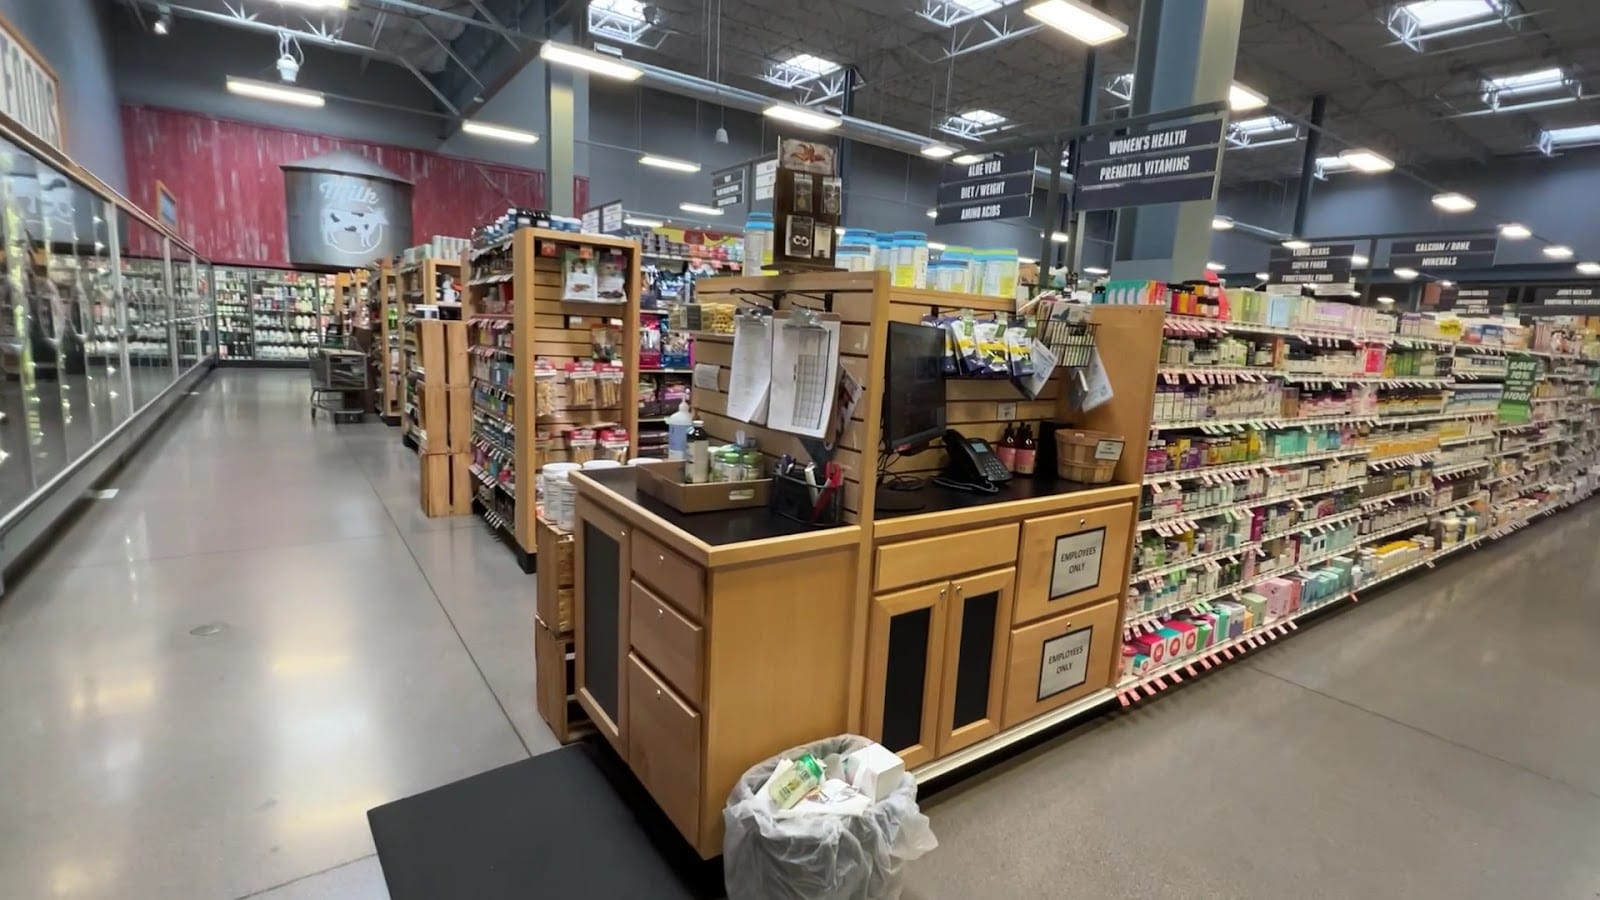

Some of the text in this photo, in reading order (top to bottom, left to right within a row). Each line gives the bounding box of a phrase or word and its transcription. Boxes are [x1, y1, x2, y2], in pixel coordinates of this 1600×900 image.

[1109, 129, 1187, 155] WOMEN'S HEALTH
[967, 160, 1001, 178] ALOE VERA
[1100, 155, 1190, 181] PRENATAL VITAMINS
[319, 182, 379, 204] Milk
[961, 185, 975, 200] DIET
[980, 181, 1005, 197] WEIGHT
[961, 204, 1001, 220] AMINO ACIDS
[1415, 242, 1445, 253] CALCIUM
[1450, 241, 1470, 251] BONE
[1422, 256, 1458, 267] MINERALS
[1061, 546, 1096, 563] EMPLOYEES
[1068, 562, 1085, 574] ONLY
[1048, 645, 1083, 665] EMPLOYEES
[1056, 662, 1073, 675] ONLY
